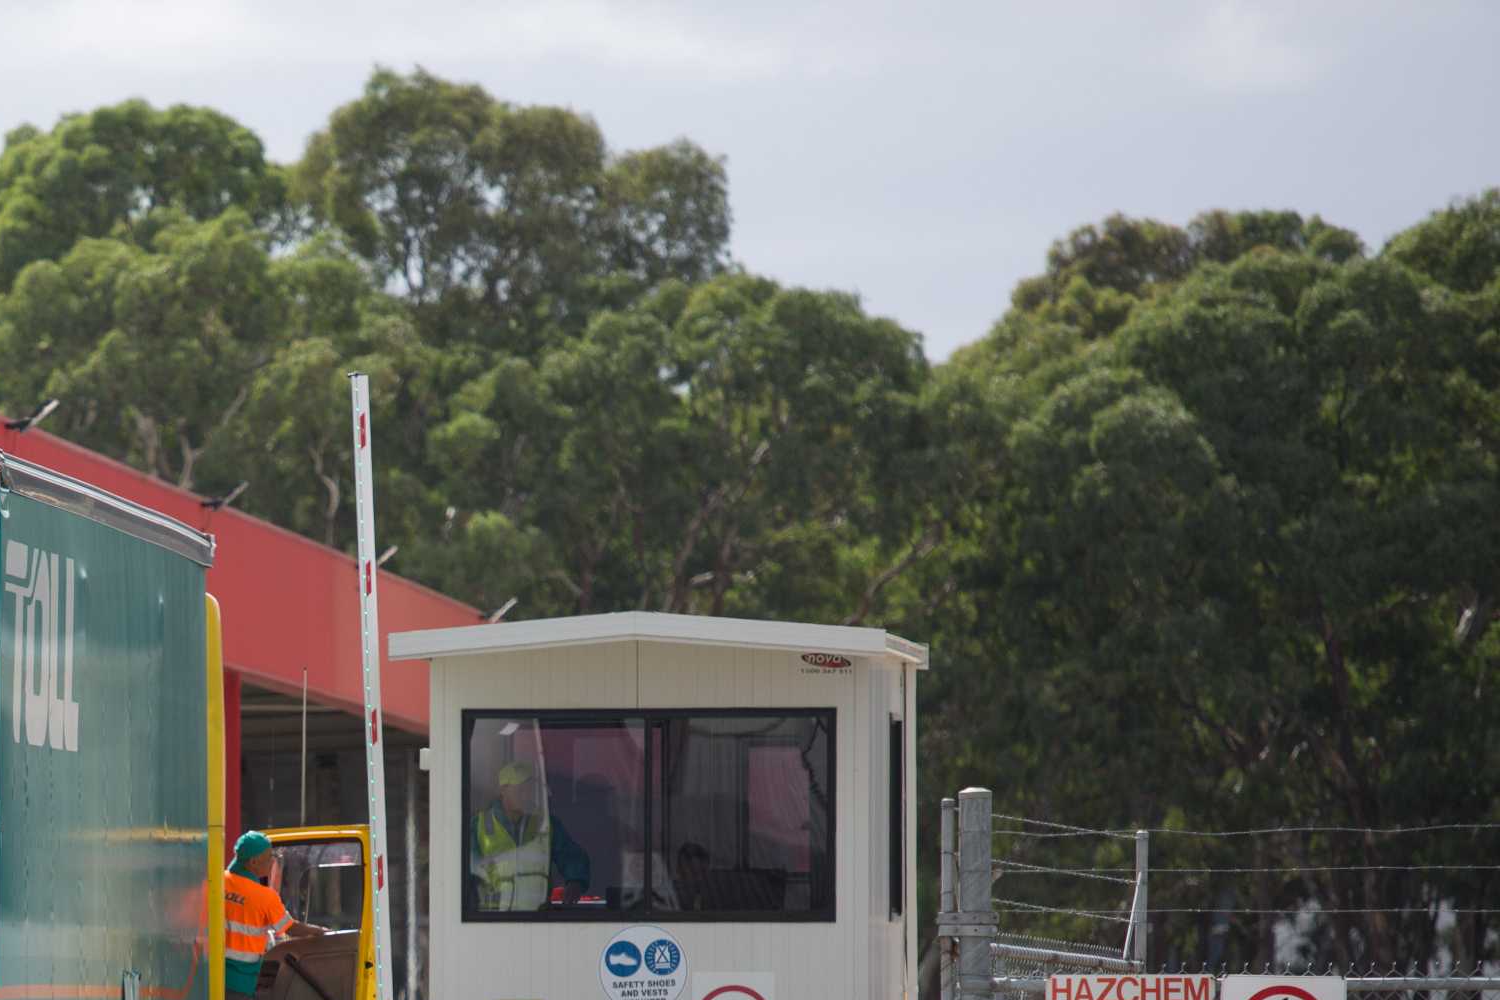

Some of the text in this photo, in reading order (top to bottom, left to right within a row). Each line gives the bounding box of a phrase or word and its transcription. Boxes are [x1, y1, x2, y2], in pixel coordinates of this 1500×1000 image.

[5, 545, 79, 752] TOLL
[612, 979, 676, 989] SAFETY SHOES
[621, 988, 668, 998] AND VESTS
